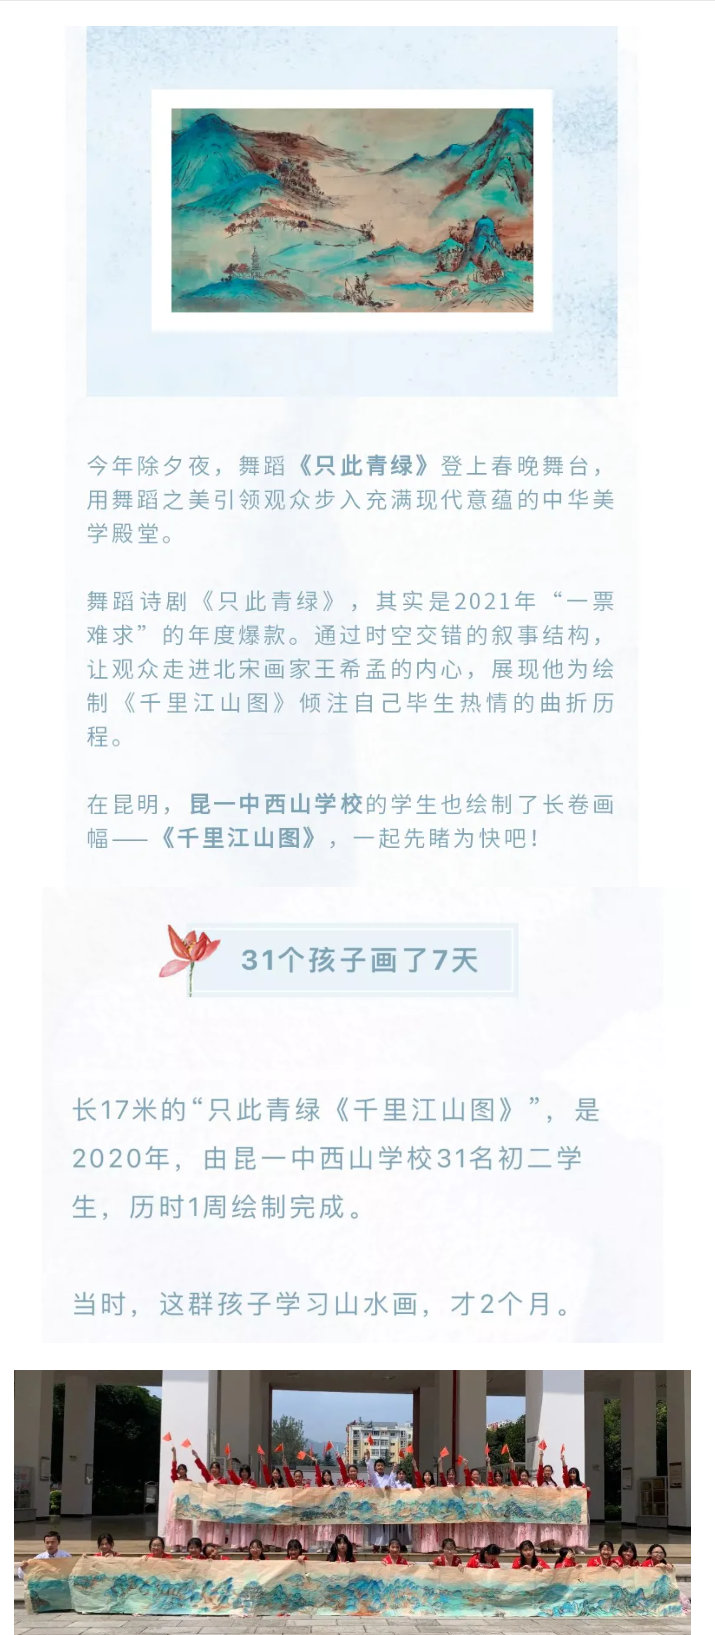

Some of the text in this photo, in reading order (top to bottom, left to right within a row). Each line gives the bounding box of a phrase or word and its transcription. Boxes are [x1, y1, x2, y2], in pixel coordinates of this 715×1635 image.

[87, 522, 172, 544] 学殿堂。
[87, 726, 121, 748] 程。
[241, 947, 479, 974] 31个孩子画了7天
[72, 1194, 365, 1220] 生，历时1周绘制完成。
